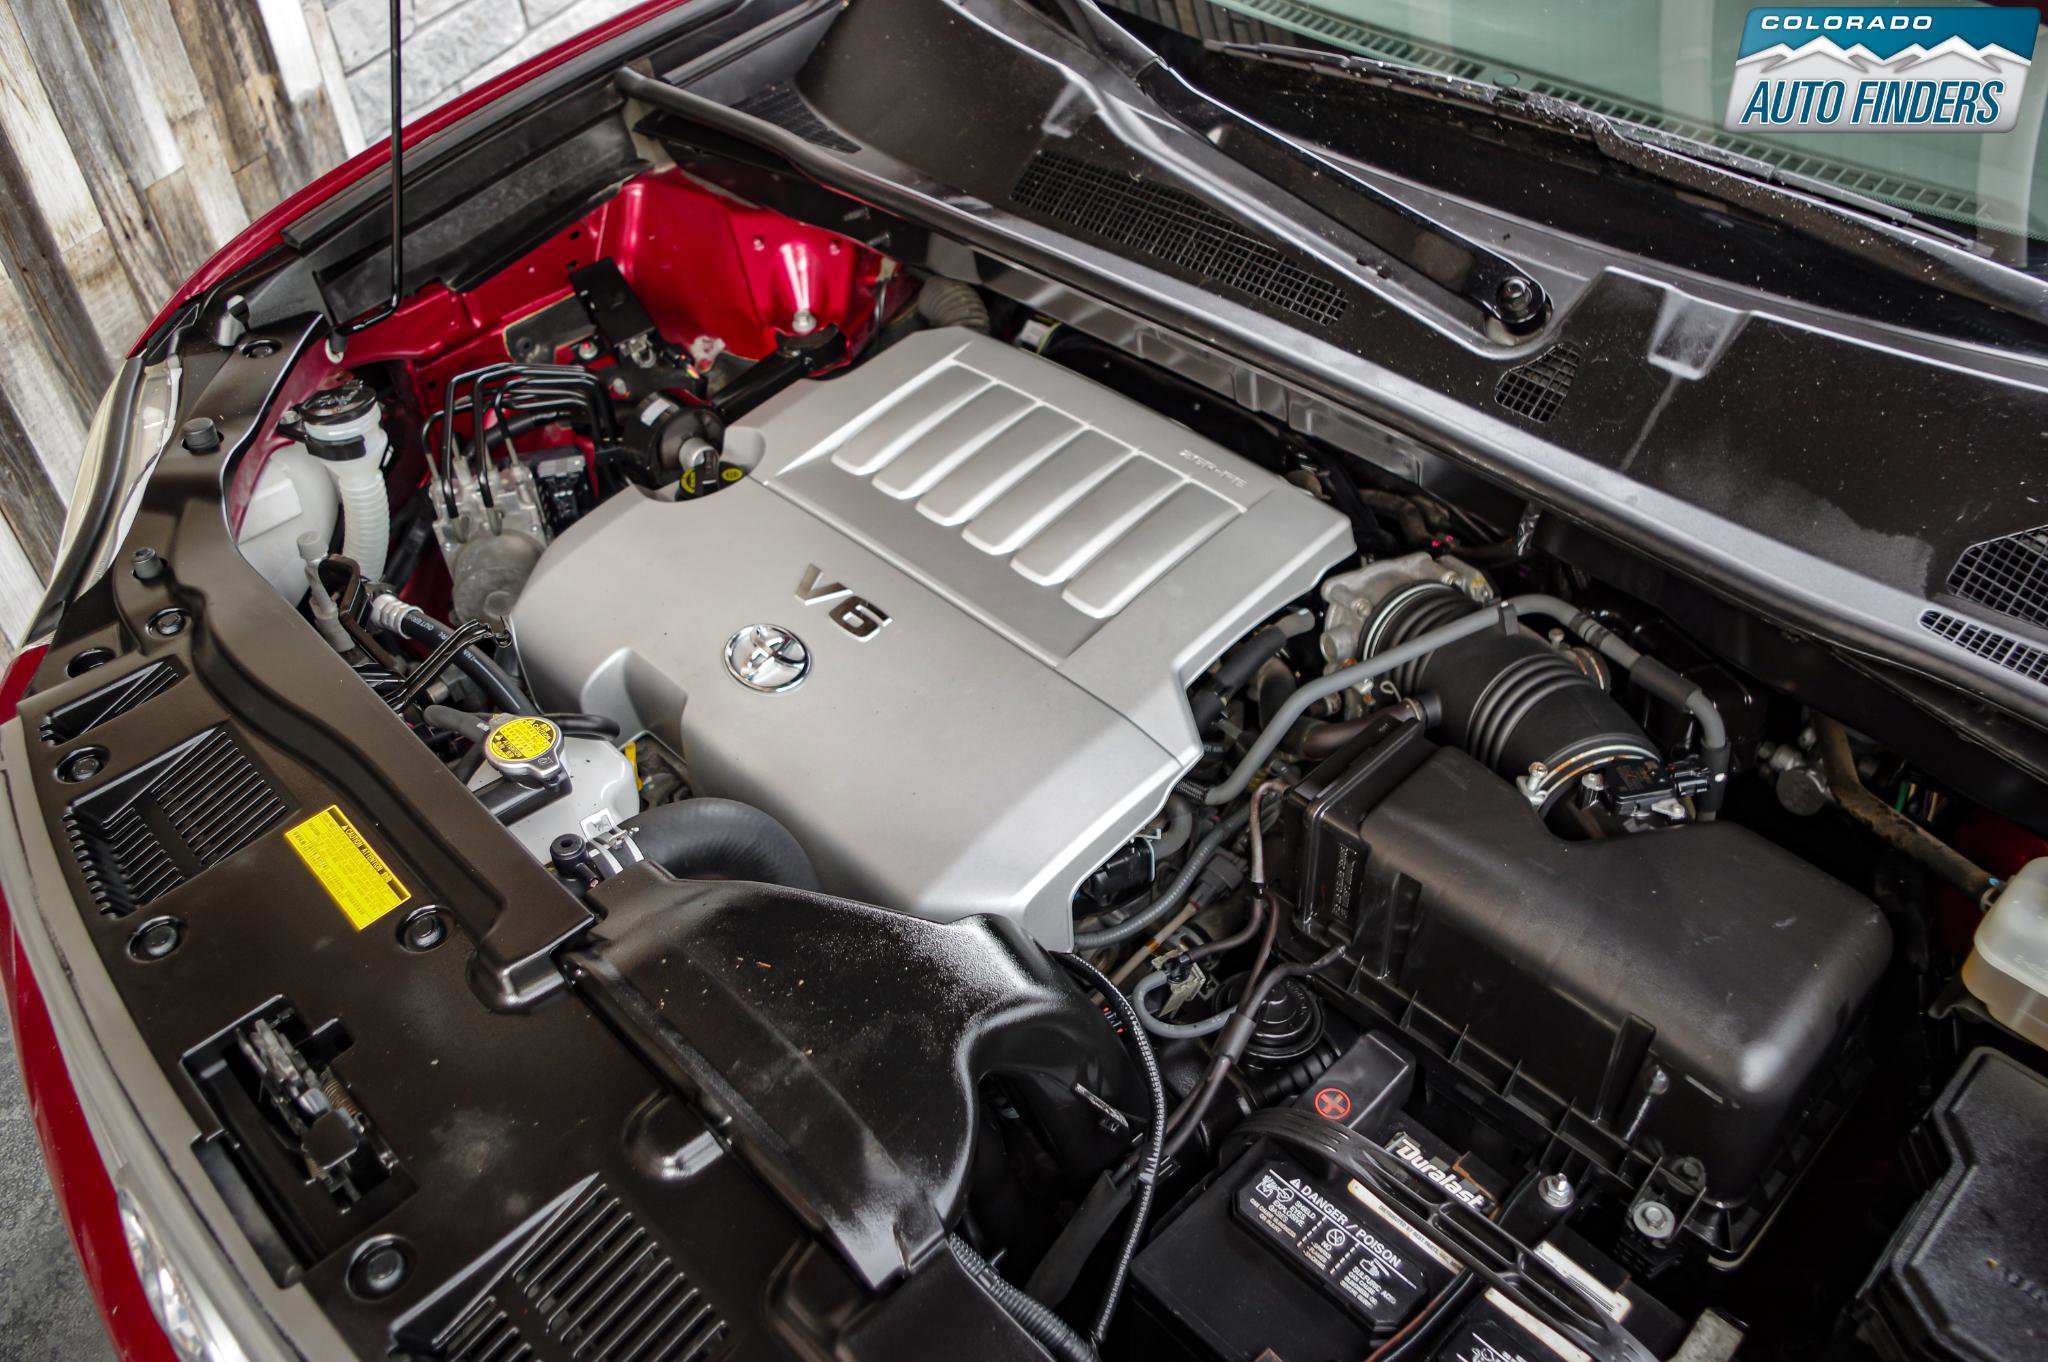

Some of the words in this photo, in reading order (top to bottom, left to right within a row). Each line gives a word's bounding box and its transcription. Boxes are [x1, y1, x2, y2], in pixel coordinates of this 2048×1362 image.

[795, 563, 892, 642] V6
[1395, 1138, 1487, 1209] Duralast
[1266, 1203, 1289, 1223] GASES
[1271, 1198, 1305, 1227] EXPLOSIVE
[1288, 1204, 1307, 1220] EYES
[1293, 1199, 1317, 1220] SHIELD
[1299, 1183, 1349, 1226] DANGER
[1354, 1227, 1402, 1268] POISON
[1319, 1239, 1333, 1252] NO
[1350, 1265, 1382, 1292] SULFURIC
[1379, 1289, 1397, 1305] ACID
